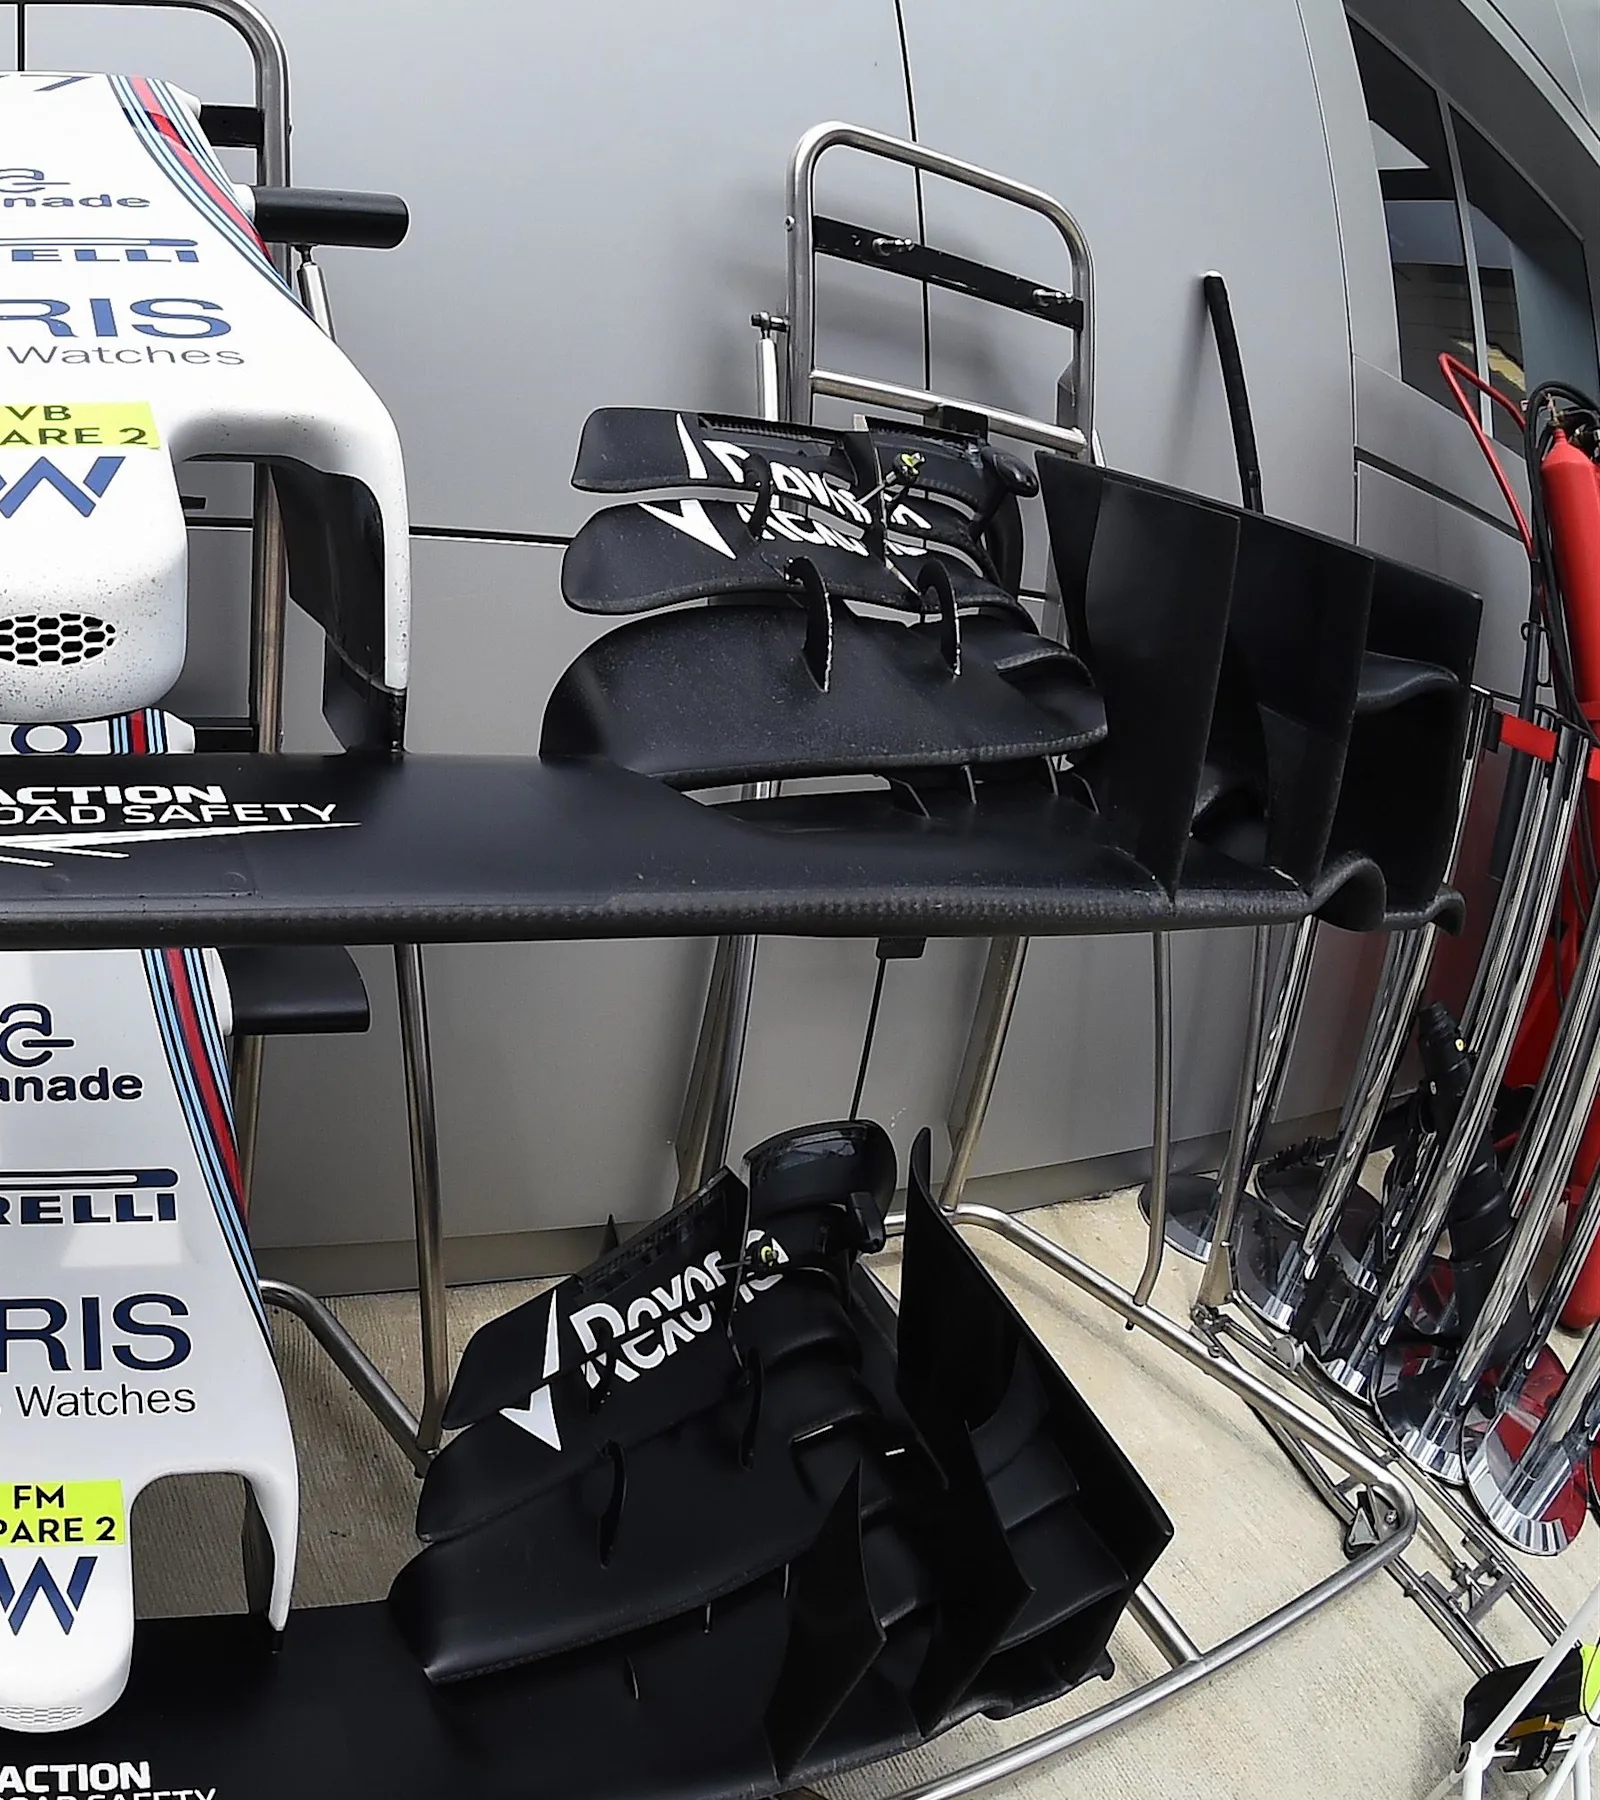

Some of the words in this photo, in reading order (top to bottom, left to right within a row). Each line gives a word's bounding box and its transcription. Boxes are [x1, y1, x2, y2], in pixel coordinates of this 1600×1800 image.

[6, 345, 245, 367] Watches
[5, 405, 72, 422] VB
[120, 427, 148, 446] 2
[122, 803, 337, 825] SAFETY
[15, 1383, 196, 1418] Watches
[13, 1484, 65, 1510] FM
[95, 1516, 116, 1541] 2
